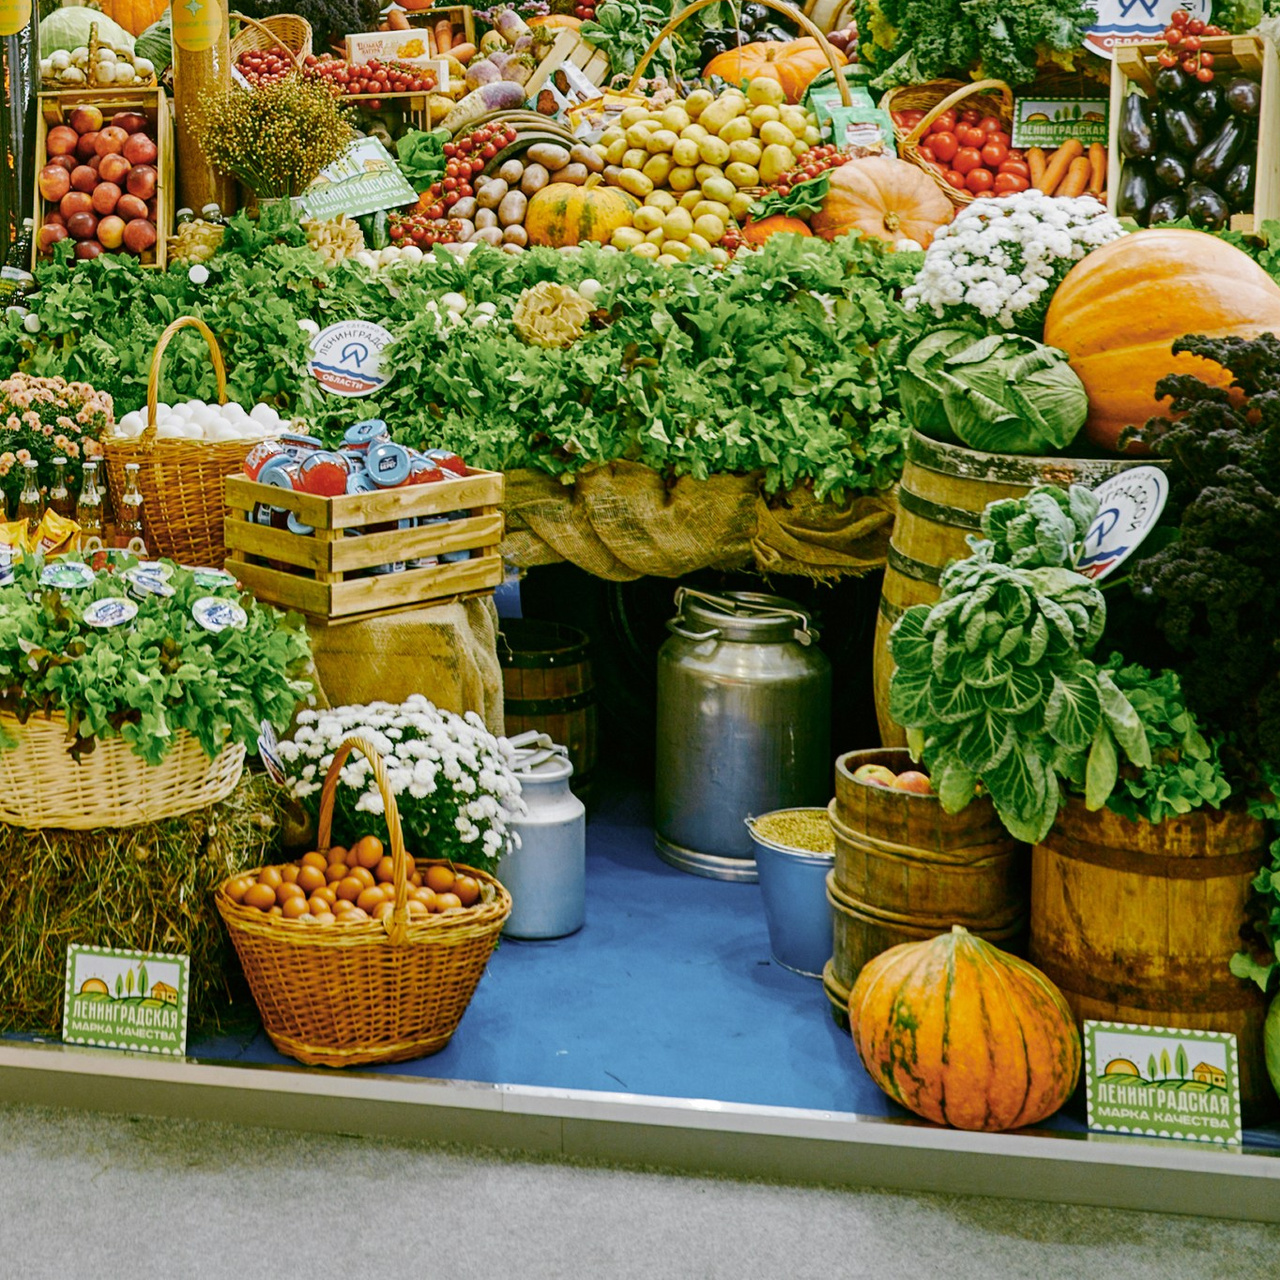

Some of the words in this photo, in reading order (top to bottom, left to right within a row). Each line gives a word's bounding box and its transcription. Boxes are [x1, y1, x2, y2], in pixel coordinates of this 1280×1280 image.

[1021, 125, 1106, 135] ЛЕНИНГРАДСКАЯ
[308, 174, 403, 207] ЛЕНИНГРАДСКАЯ
[315, 200, 353, 215] МАРКА
[355, 189, 408, 206] КАЧЕСТВА
[322, 373, 364, 390] ОБЛАСТИ
[73, 1000, 179, 1029] ЛЕНИНГРАДСКАЯ
[72, 1020, 113, 1034] МАРКА
[116, 1026, 177, 1042] КАЧЕСТВА
[1098, 1083, 1230, 1115] ЛЕНИНГРАДСКАЯ
[1098, 1106, 1150, 1120] МАРКА
[1154, 1112, 1230, 1129] КАЧЕСТВА
